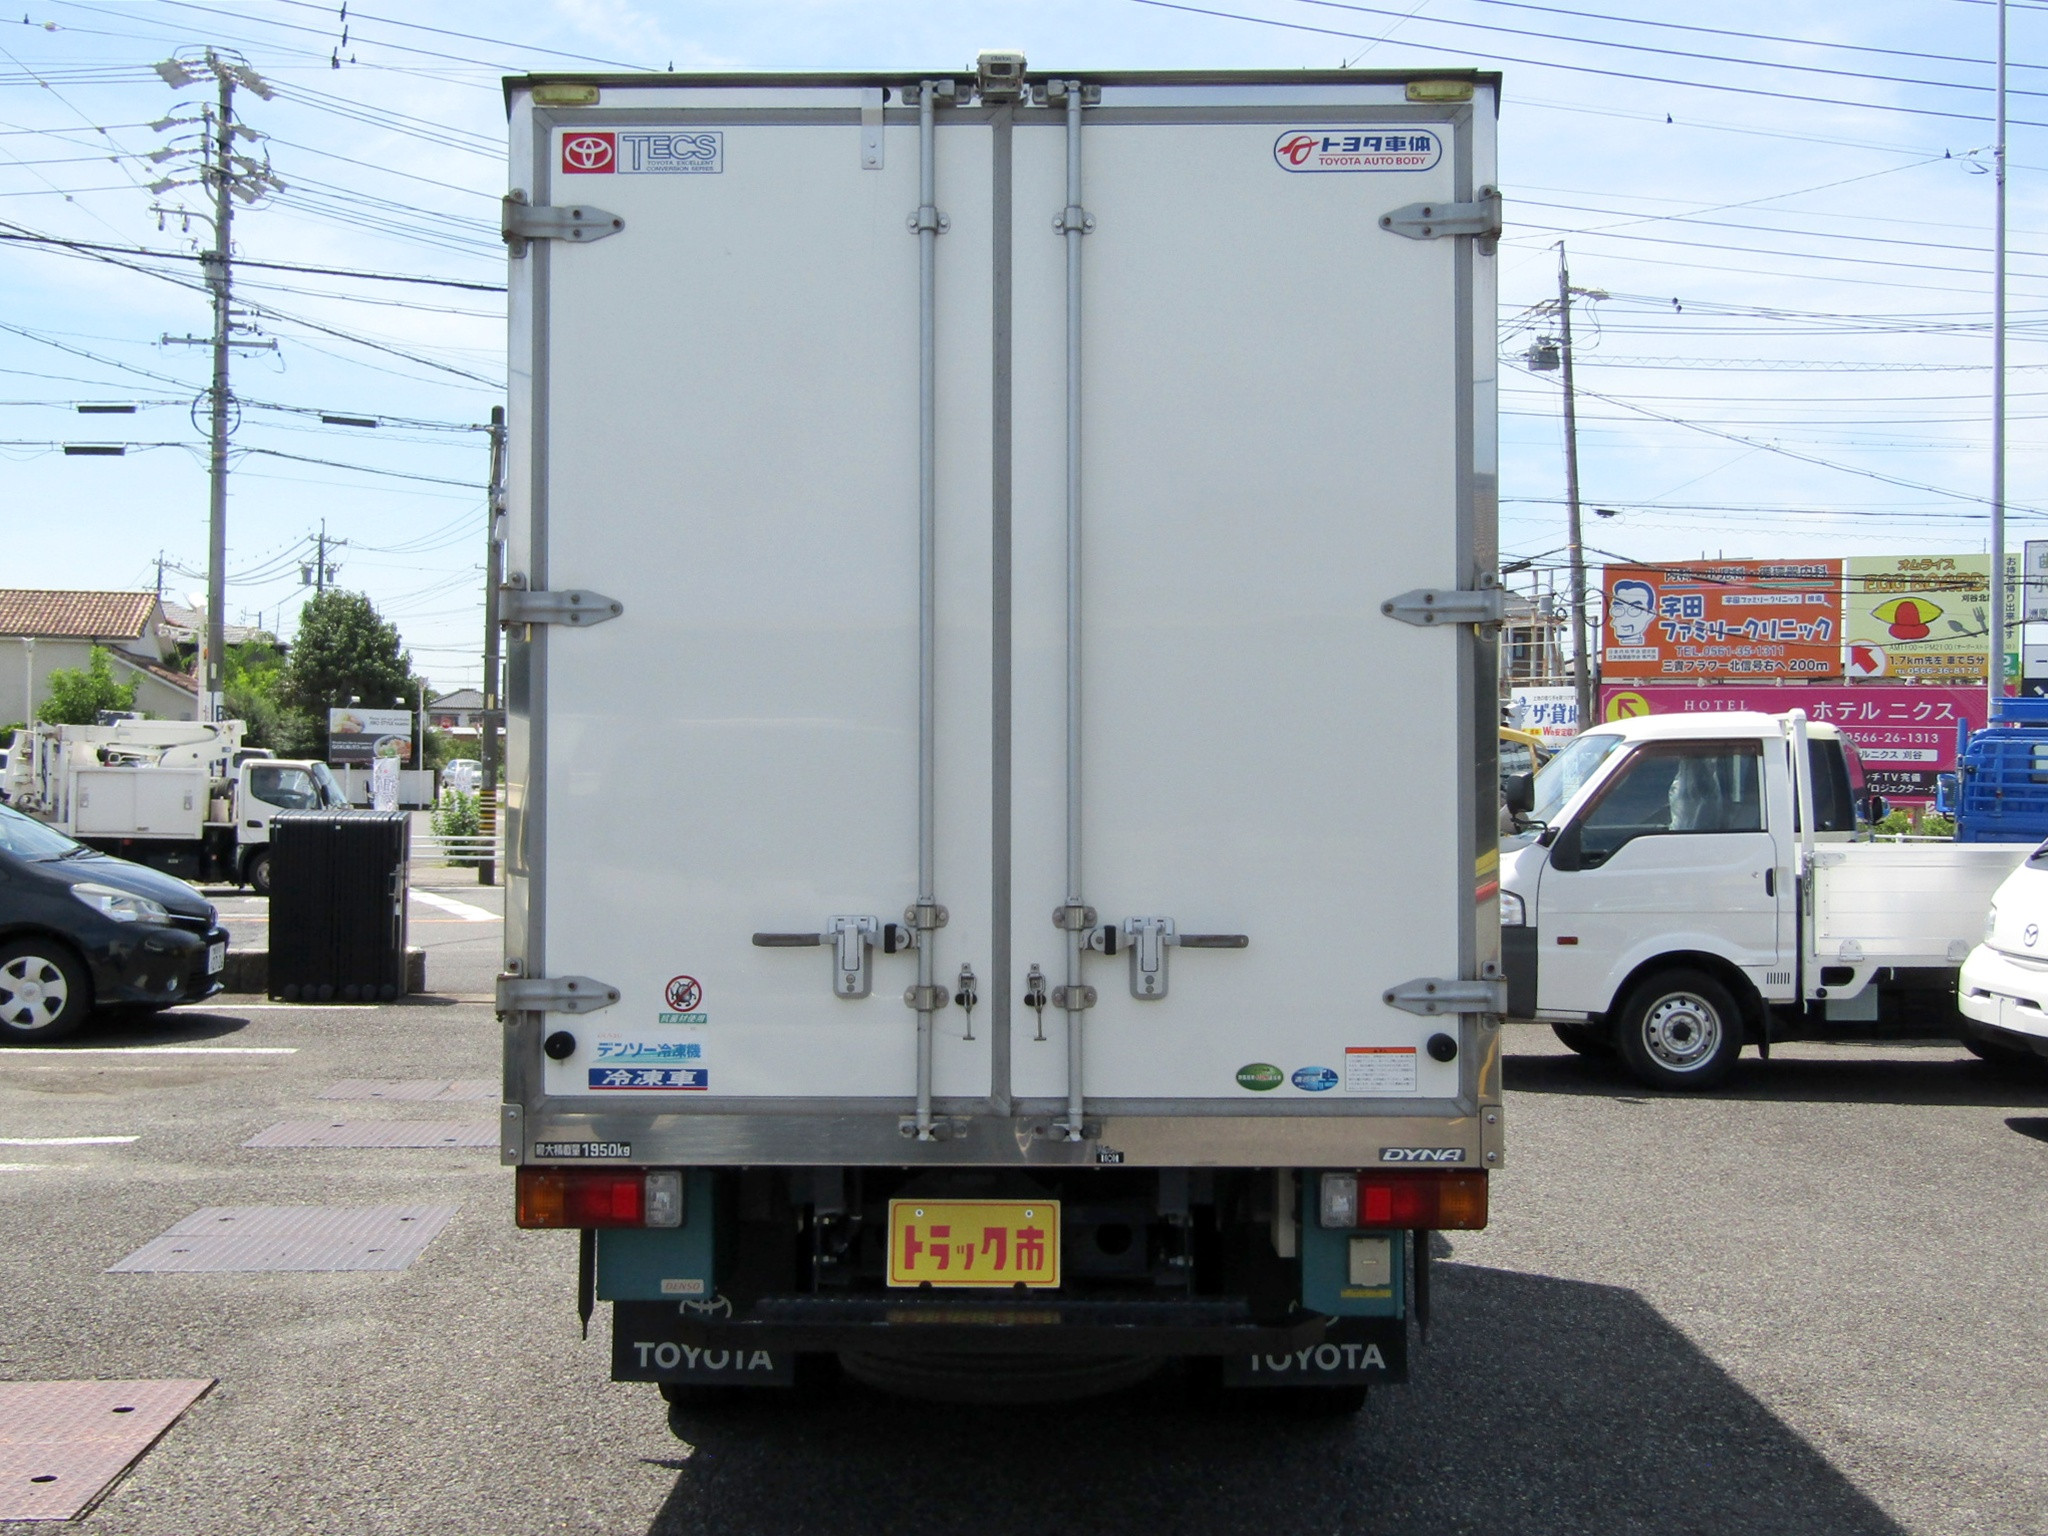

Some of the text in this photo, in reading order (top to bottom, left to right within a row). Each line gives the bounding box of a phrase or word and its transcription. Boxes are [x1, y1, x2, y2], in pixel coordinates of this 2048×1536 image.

[1321, 136, 1431, 152] トヨタ車体
[622, 134, 716, 171] TECS
[1319, 157, 1426, 166] TOYOTA AUTO BODY
[1898, 558, 1956, 571] オムライス
[1910, 573, 1989, 592] BOARD
[1660, 595, 1703, 618] 宇田
[1961, 594, 1990, 603] 刈谷北
[1659, 616, 1833, 642] ファミリークリニック
[1789, 659, 1829, 672] 200m
[1889, 655, 1985, 666] 1.7km先左 車で5分
[1684, 700, 1748, 711] HOTEL
[1813, 701, 1956, 721] ホテル ニクス
[1860, 750, 1923, 760] ルニクス 刈谷
[602, 1069, 697, 1086] 冷凍車
[1382, 1148, 1459, 1161] DYNA
[903, 1223, 1045, 1271] トラック市
[665, 1282, 700, 1290] DENSO
[633, 1341, 773, 1371] TOYOTA
[1252, 1343, 1386, 1371] TOYOTA
